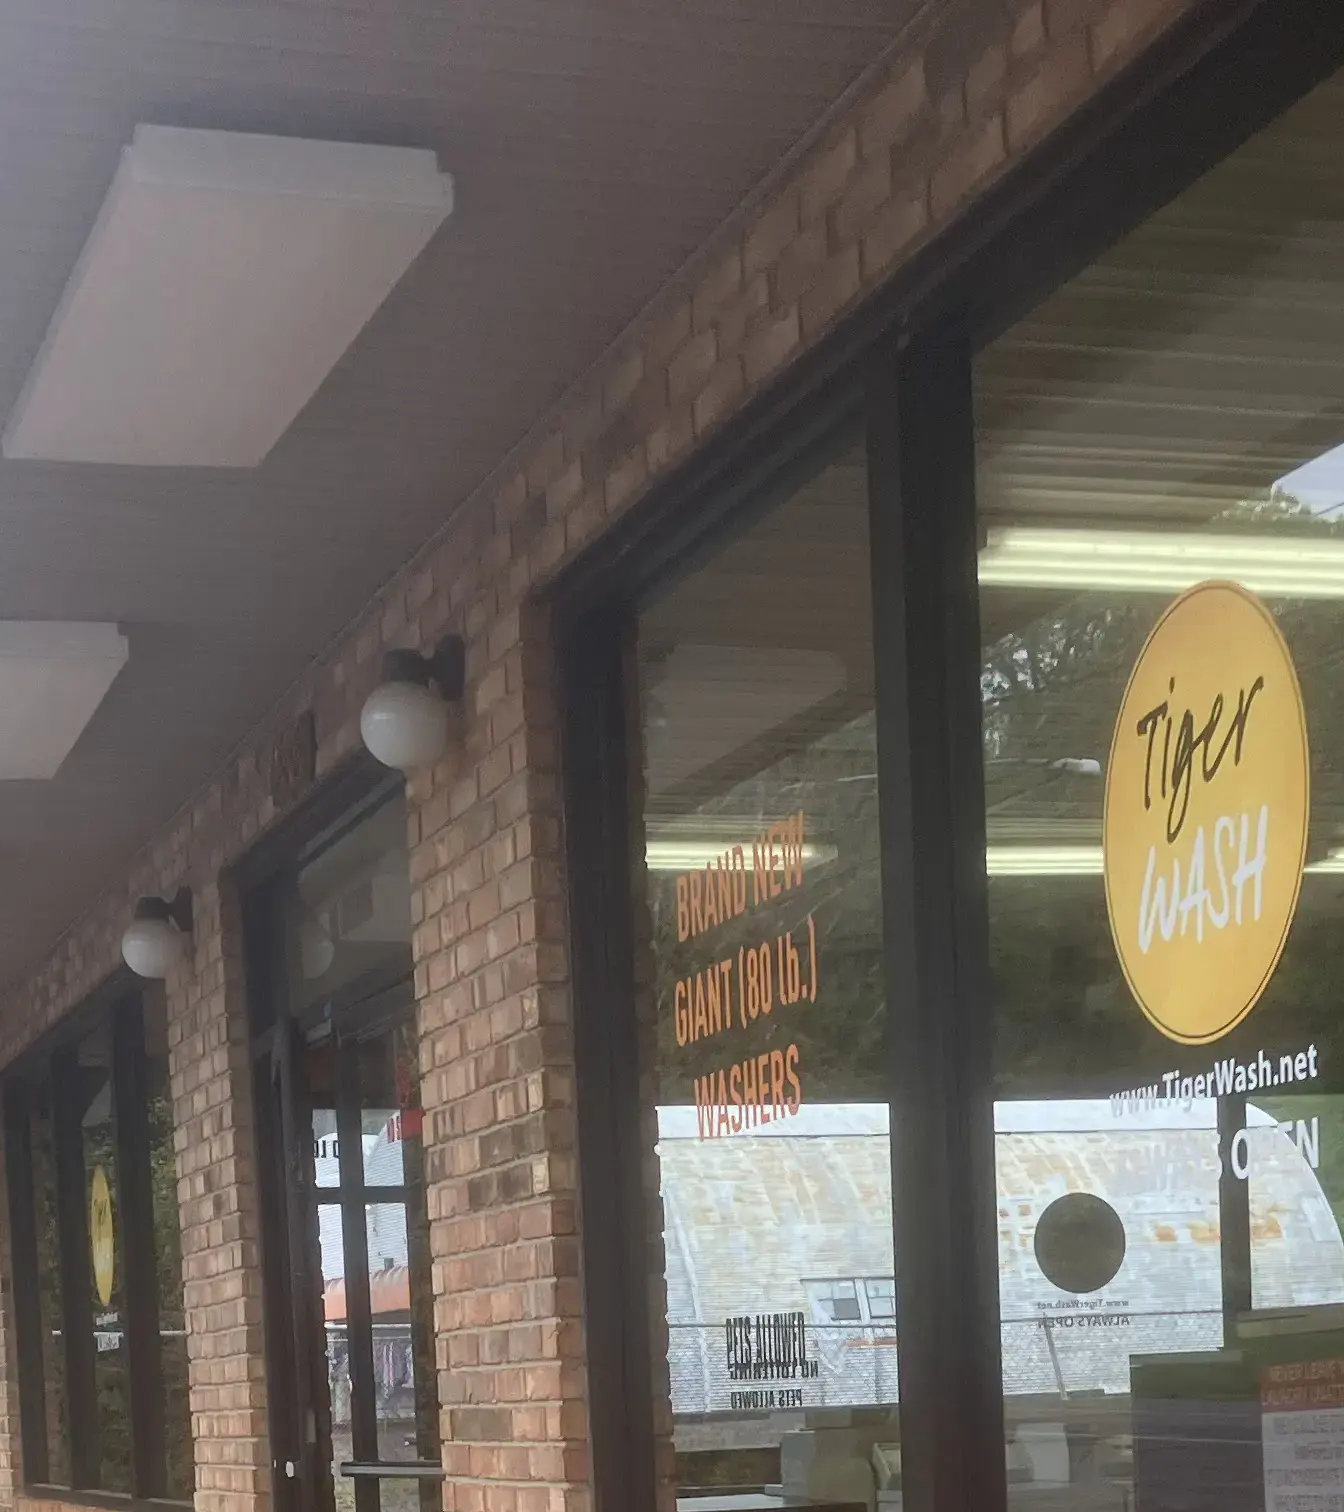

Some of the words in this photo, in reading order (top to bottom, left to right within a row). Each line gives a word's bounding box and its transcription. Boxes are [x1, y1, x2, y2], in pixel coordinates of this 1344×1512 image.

[1136, 676, 1264, 844] Tiger
[676, 844, 746, 943] BRAND
[752, 810, 804, 907] NEW
[1137, 804, 1268, 954] WASH
[674, 958, 733, 1048] GIANT
[739, 941, 772, 1029] (80
[693, 1043, 801, 1142] WASHERS
[1109, 1043, 1319, 1117] www.TigerWash.net
